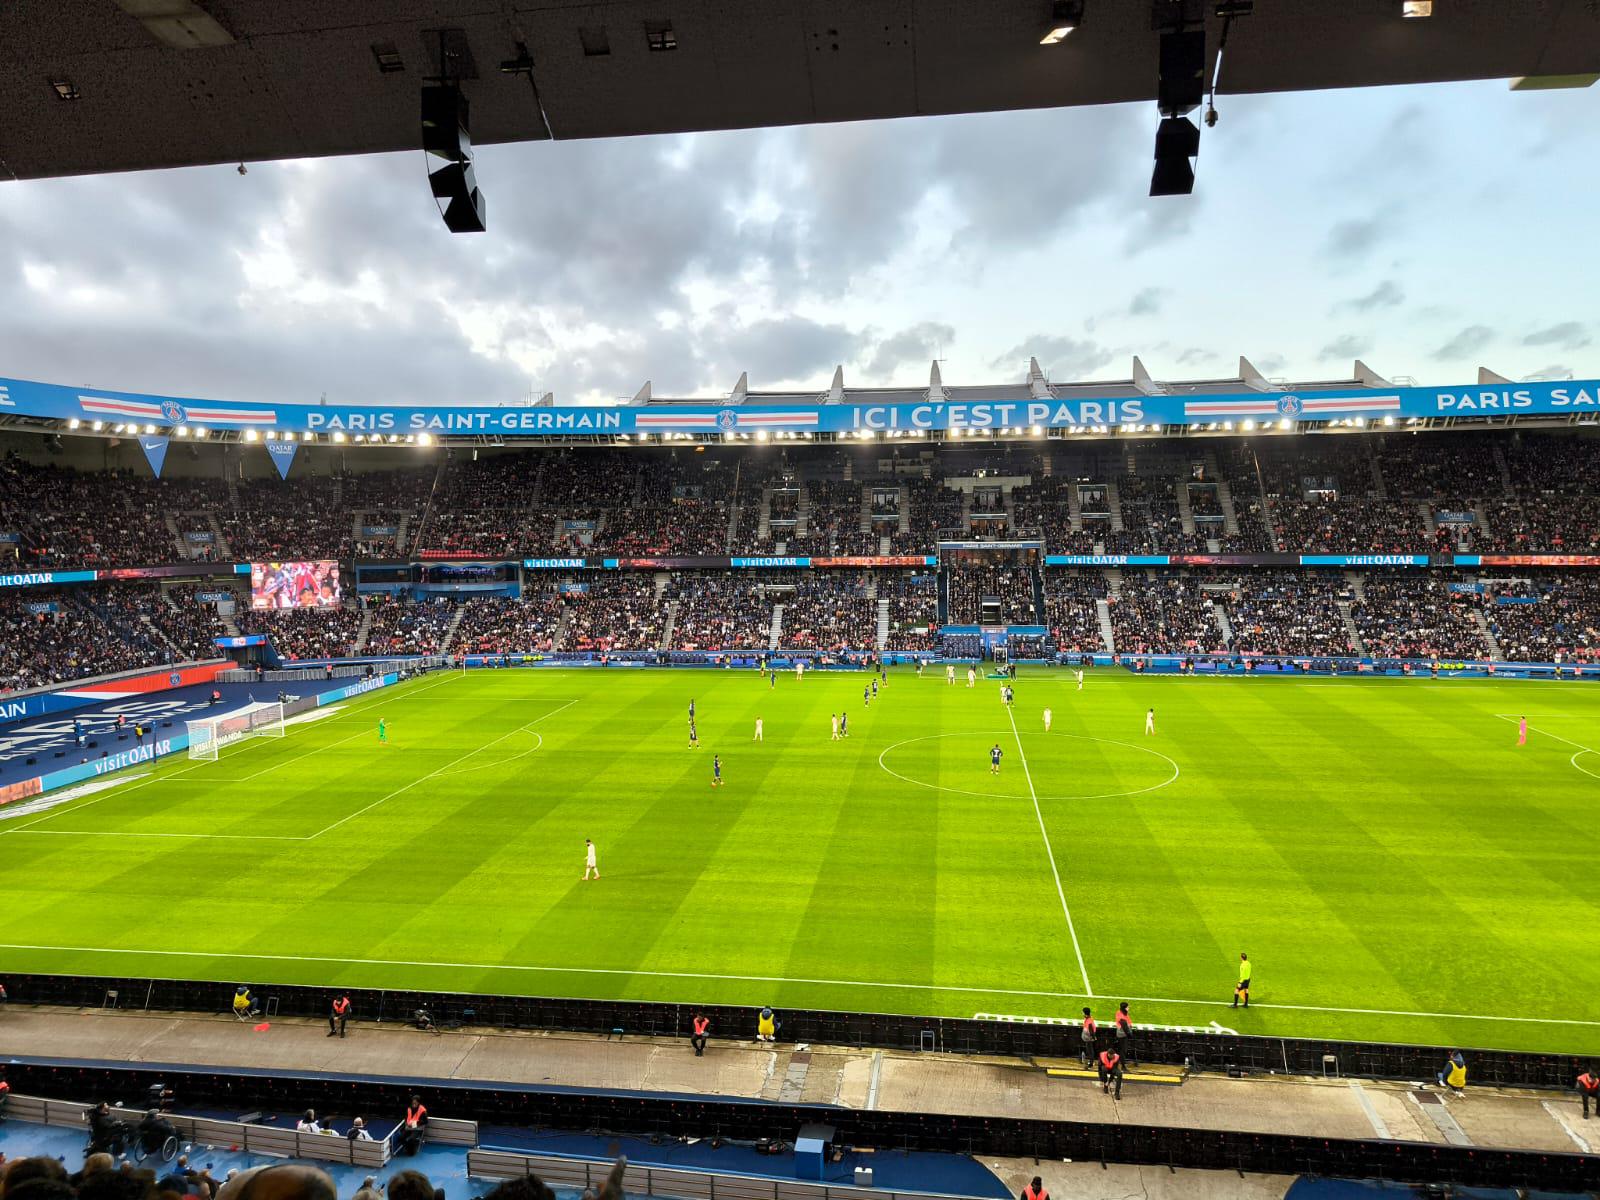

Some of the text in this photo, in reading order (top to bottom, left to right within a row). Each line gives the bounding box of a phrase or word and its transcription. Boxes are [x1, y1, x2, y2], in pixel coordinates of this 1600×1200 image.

[1437, 389, 1533, 411] PARIS
[307, 412, 621, 430] PARIS SAINT-GERMAIN
[852, 400, 1144, 429] ICI C'EST PARIS
